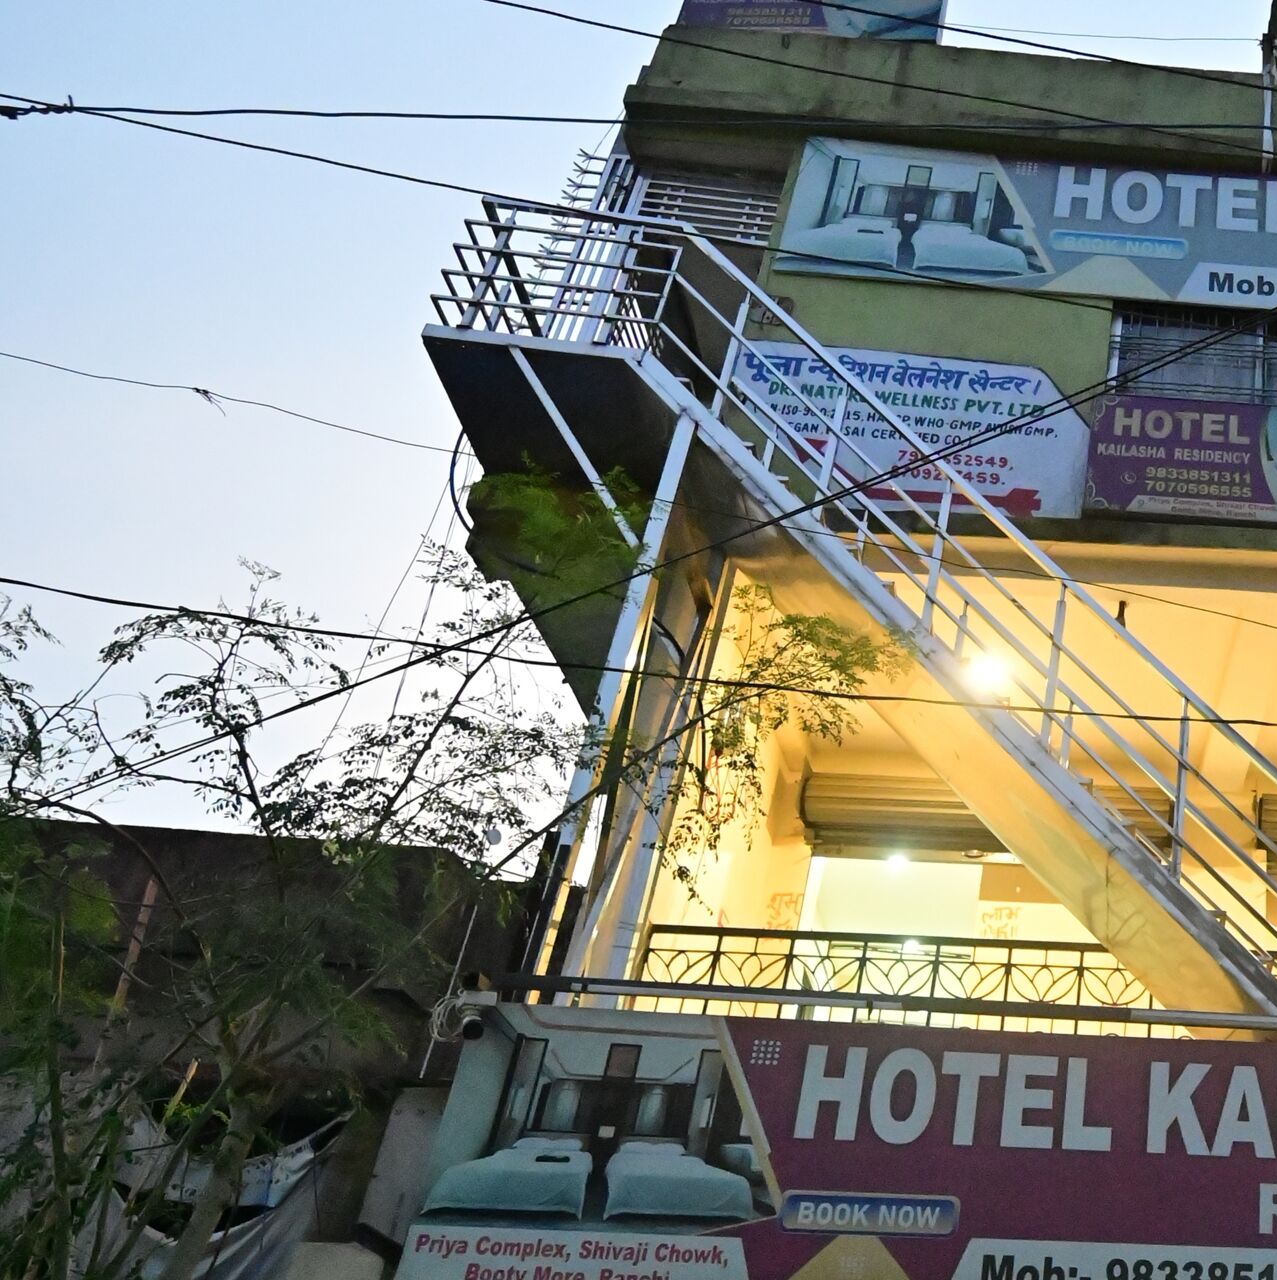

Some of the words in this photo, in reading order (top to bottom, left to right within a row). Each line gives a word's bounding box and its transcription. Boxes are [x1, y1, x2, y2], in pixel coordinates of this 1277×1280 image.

[1064, 236, 1119, 253] BOOK
[1126, 240, 1176, 256] NOW
[874, 391, 959, 412] WELLNESS
[1113, 407, 1250, 445] HOTEL
[1097, 442, 1166, 459] KAILASHA
[1174, 448, 1251, 465] RESIDENCY
[794, 1044, 1112, 1153] HOTEL
[797, 1201, 870, 1228] BOOK
[878, 1205, 941, 1229] NOW
[415, 1233, 468, 1263] Priya
[475, 1236, 572, 1263] Complex,
[579, 1239, 651, 1266] Shivaji
[656, 1242, 729, 1268] Chowk,
